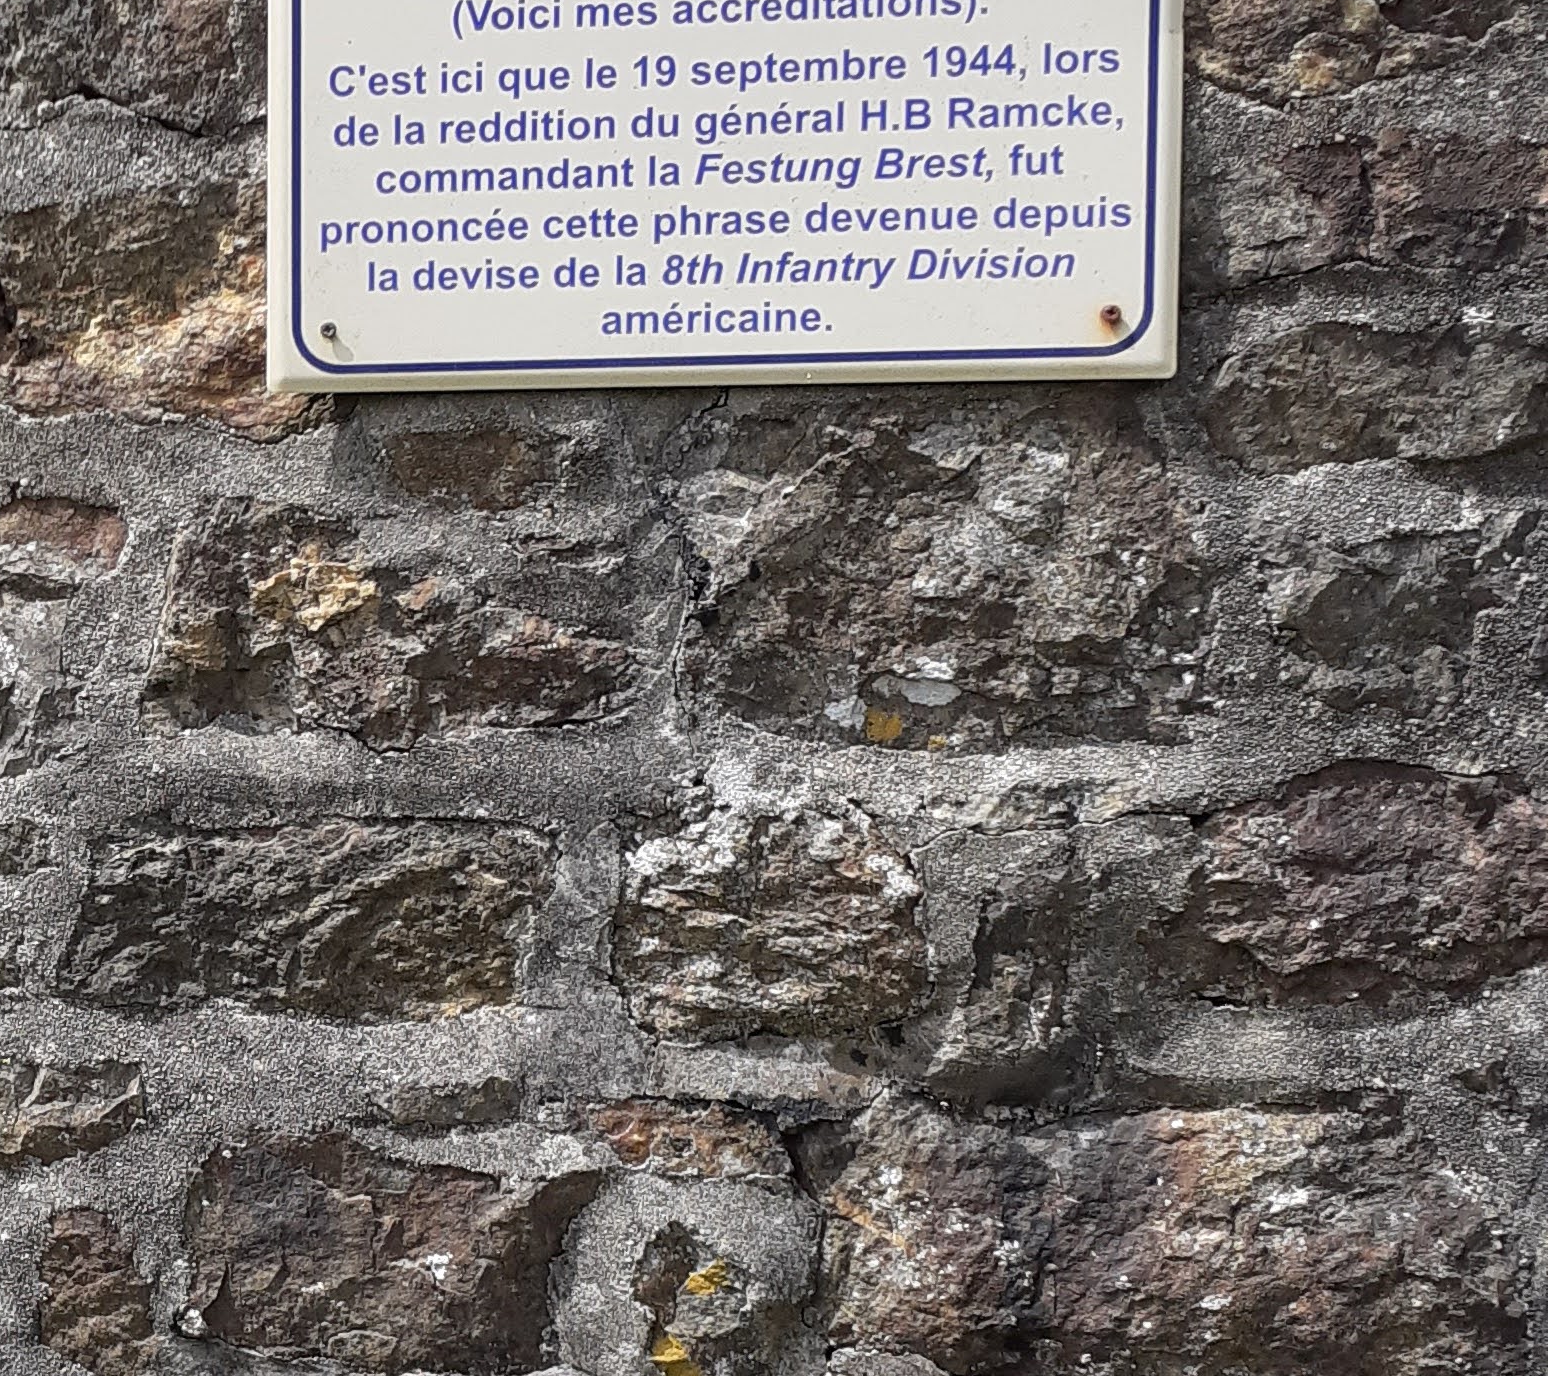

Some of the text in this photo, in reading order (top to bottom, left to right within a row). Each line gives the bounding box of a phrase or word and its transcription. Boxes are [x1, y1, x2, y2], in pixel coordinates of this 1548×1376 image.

[576, 1, 658, 28] mes
[329, 42, 1120, 100] C'est ici que le 19 septembre 1944, lors
[333, 94, 1124, 148] de la reddition du général H.B Ramcke,
[375, 143, 1064, 195] commandant la Festung Brest, fut
[320, 195, 1132, 254] prononcée cette phrase devenue depuis
[368, 246, 1076, 292] la devise de la 8th Infantry Division
[601, 301, 833, 336] américaine.
